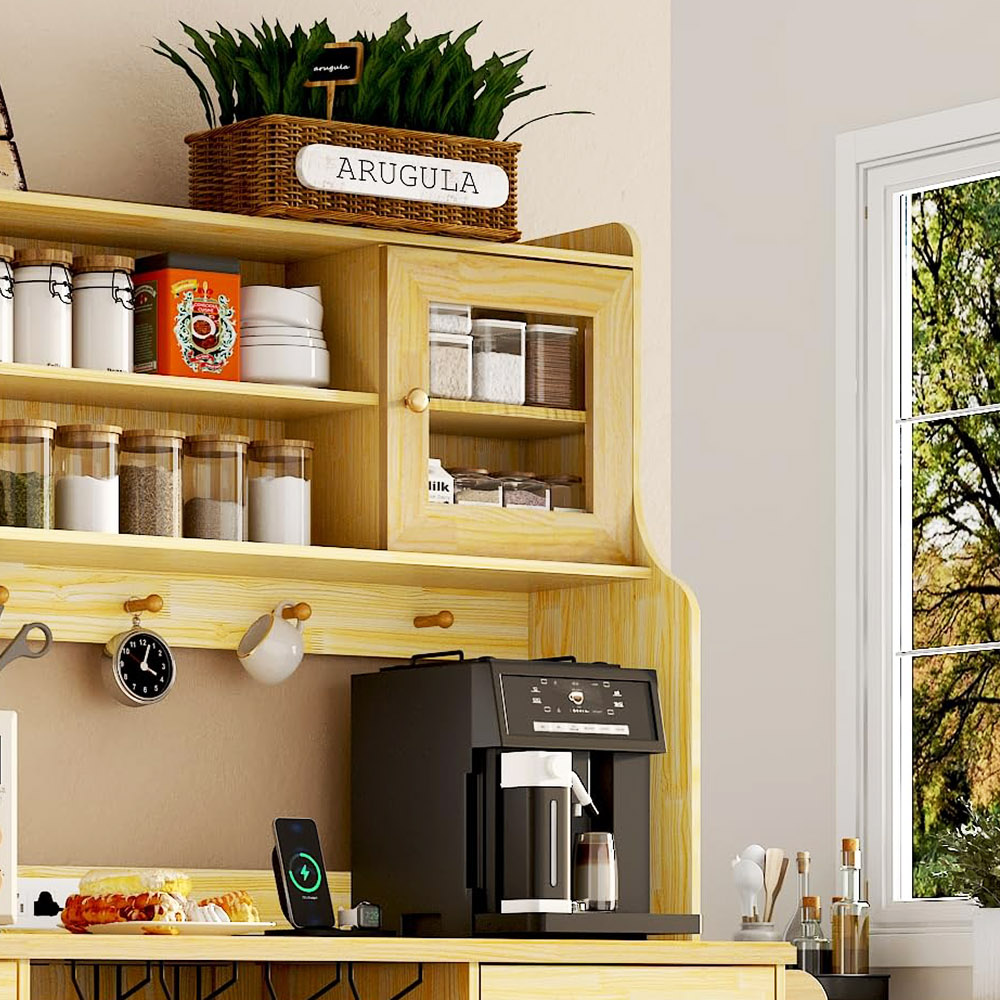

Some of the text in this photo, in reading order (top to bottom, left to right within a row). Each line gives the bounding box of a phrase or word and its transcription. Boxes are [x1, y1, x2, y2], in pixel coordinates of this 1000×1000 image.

[313, 63, 351, 73] arugula
[336, 156, 480, 195] ARUGULA
[428, 480, 450, 492] ilk
[120, 660, 125, 668] 9
[123, 673, 128, 681] 8
[143, 686, 148, 694] 6
